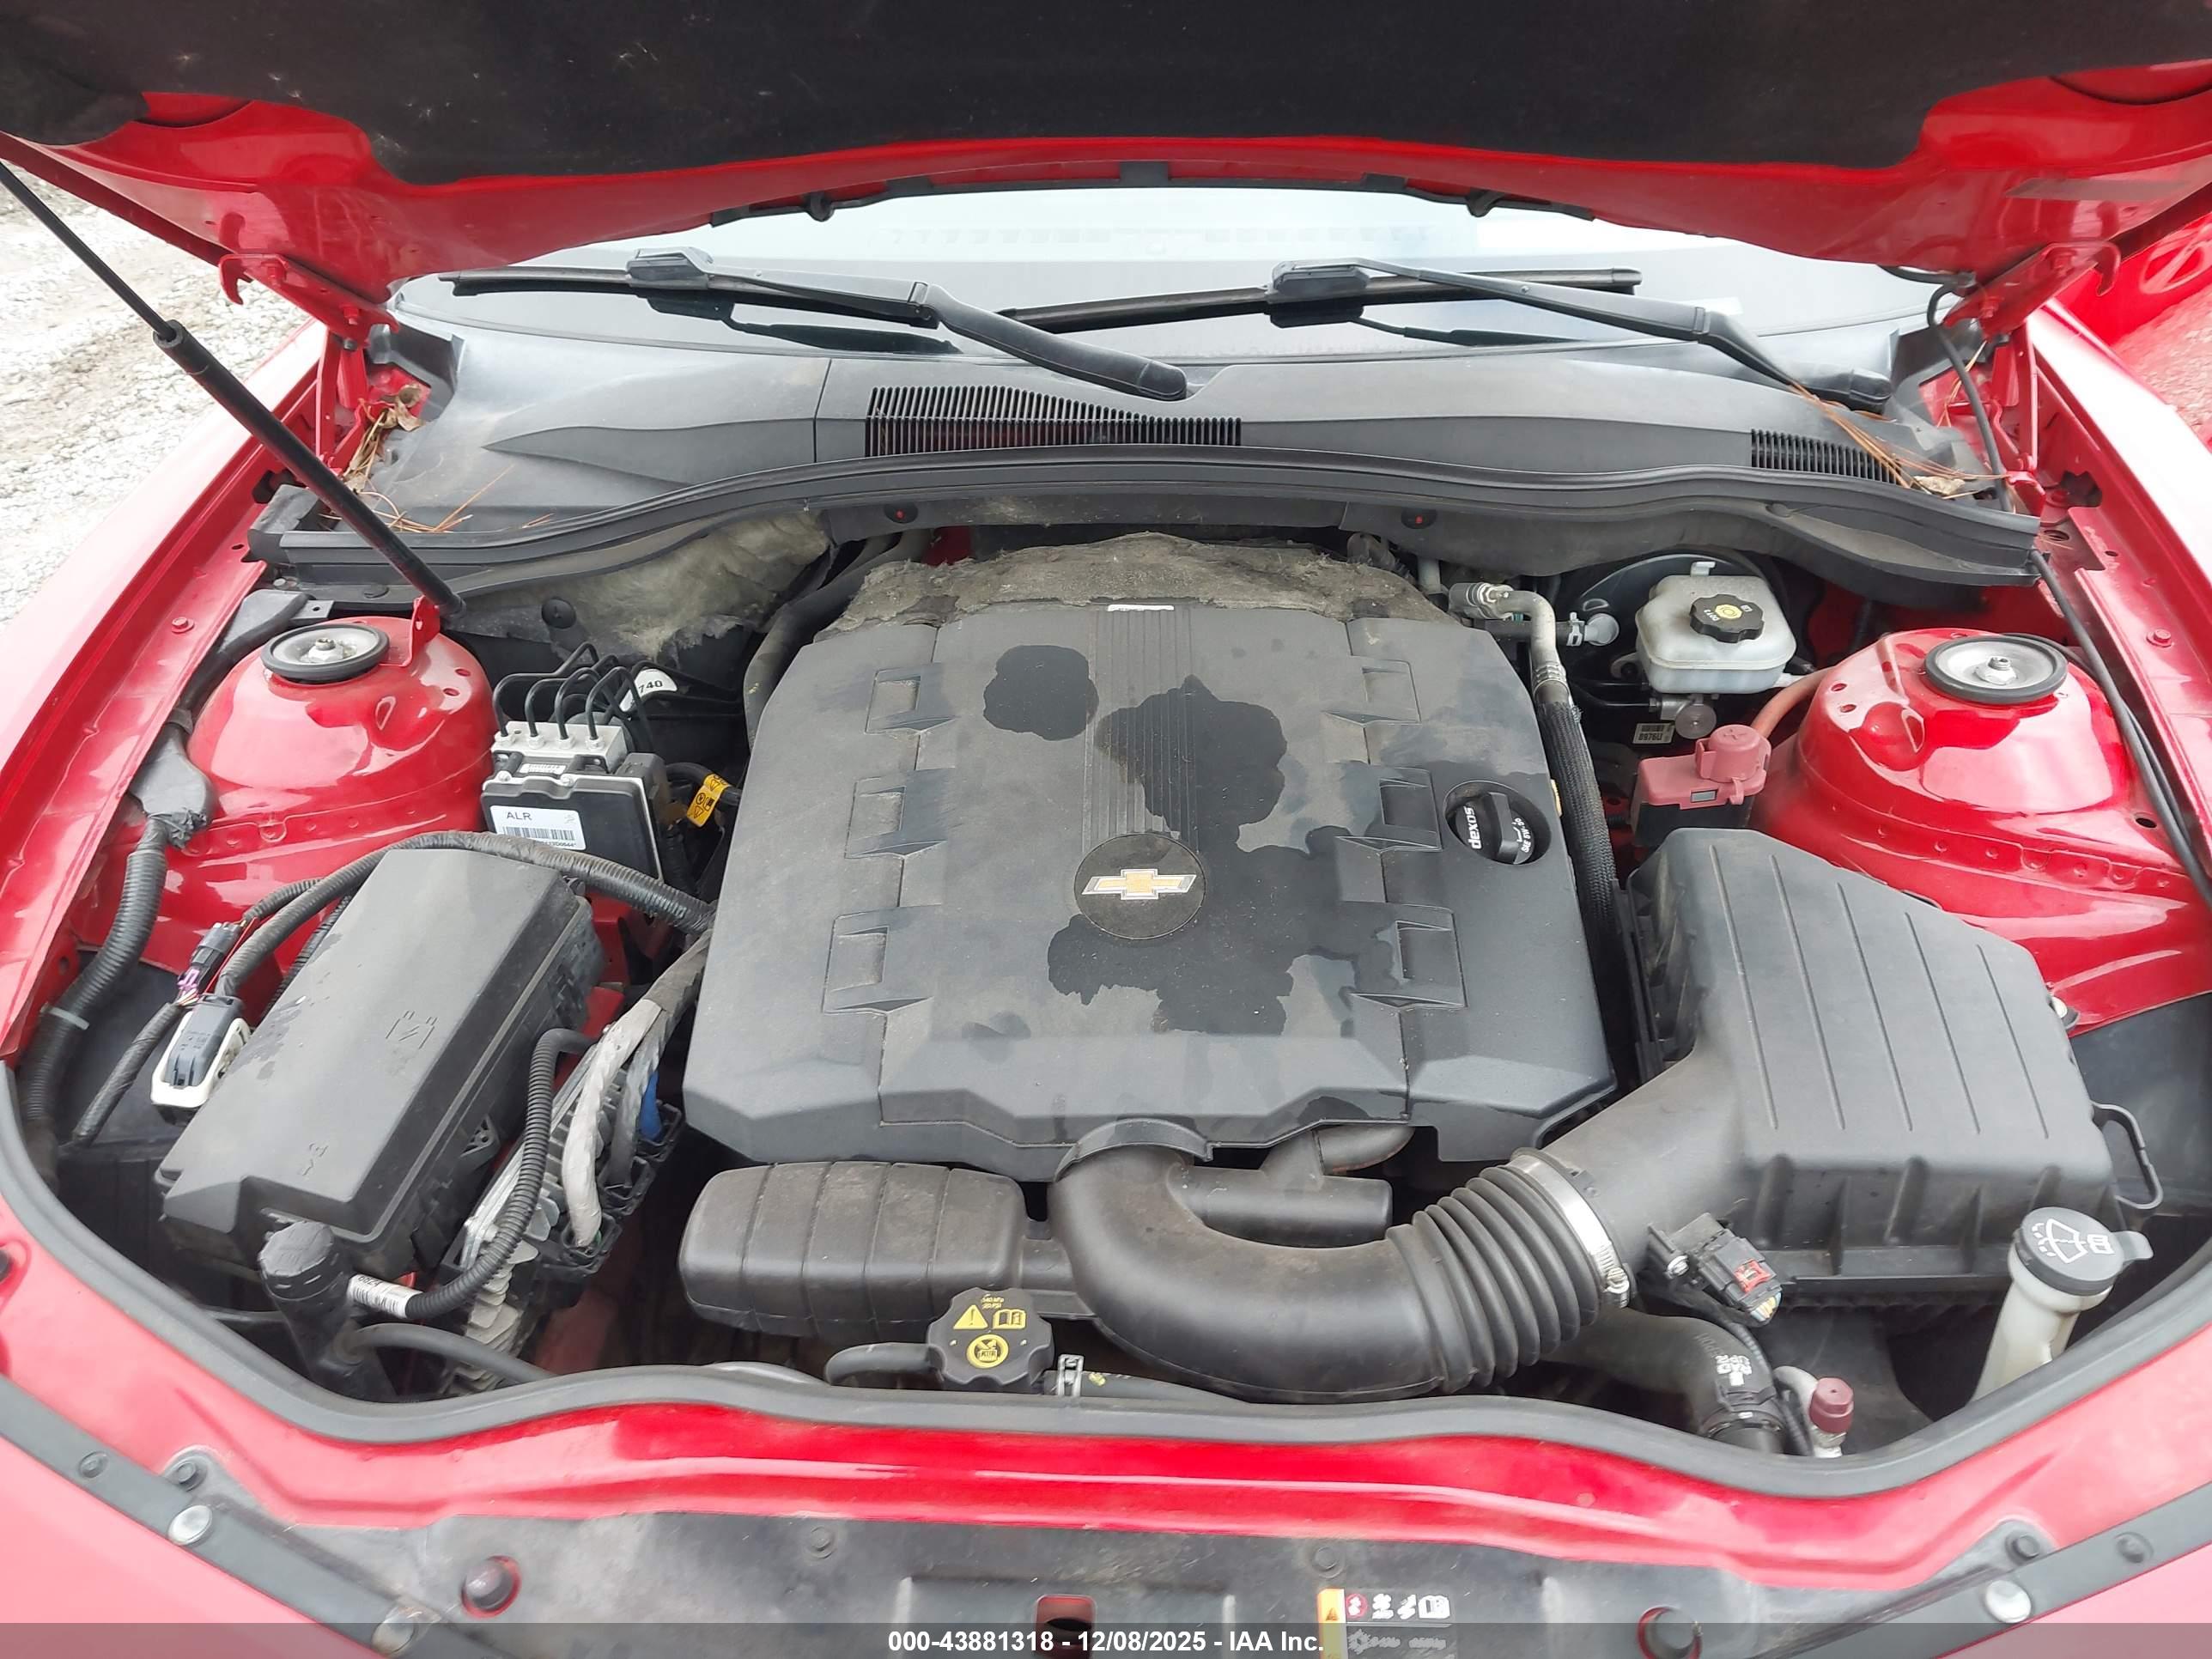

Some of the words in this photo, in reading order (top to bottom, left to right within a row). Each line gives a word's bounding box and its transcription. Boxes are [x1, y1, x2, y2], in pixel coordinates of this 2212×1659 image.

[507, 811, 532, 821] ALR
[1463, 805, 1482, 849] dexos
[1521, 840, 1532, 853] SAE
